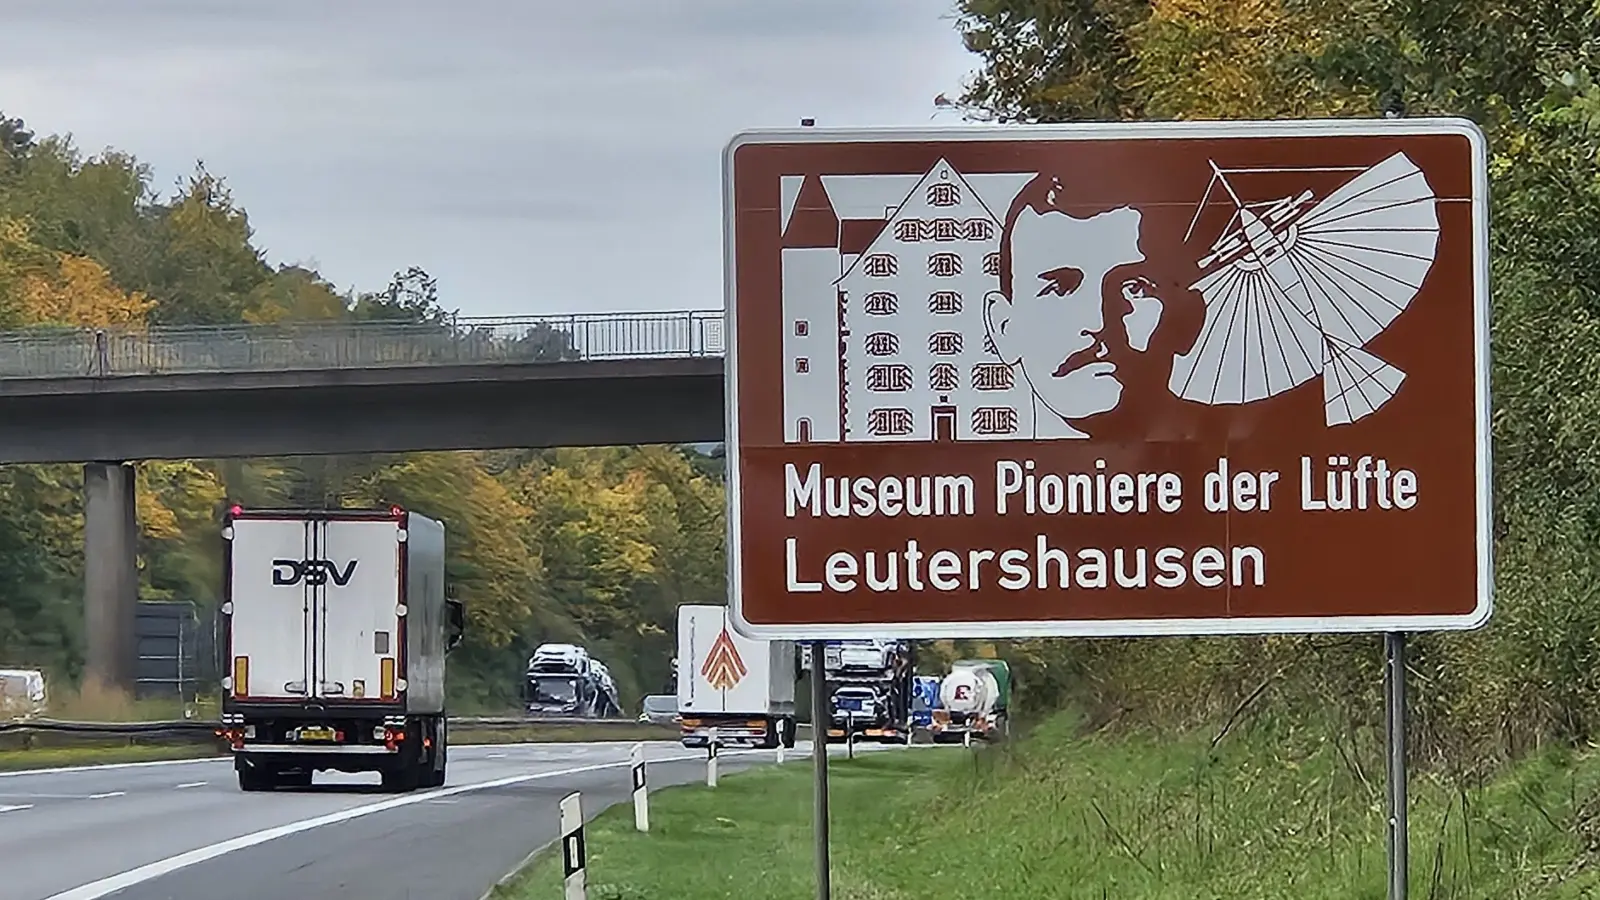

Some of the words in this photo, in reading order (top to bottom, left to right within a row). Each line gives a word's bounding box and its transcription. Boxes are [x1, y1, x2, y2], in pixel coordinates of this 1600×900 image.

[785, 463, 975, 517] Museum
[995, 459, 1182, 515] Pioniere
[1204, 457, 1280, 512] der
[1301, 455, 1418, 511] Lüfte
[272, 559, 358, 586] DSV
[786, 535, 1265, 592] Leutershausen
